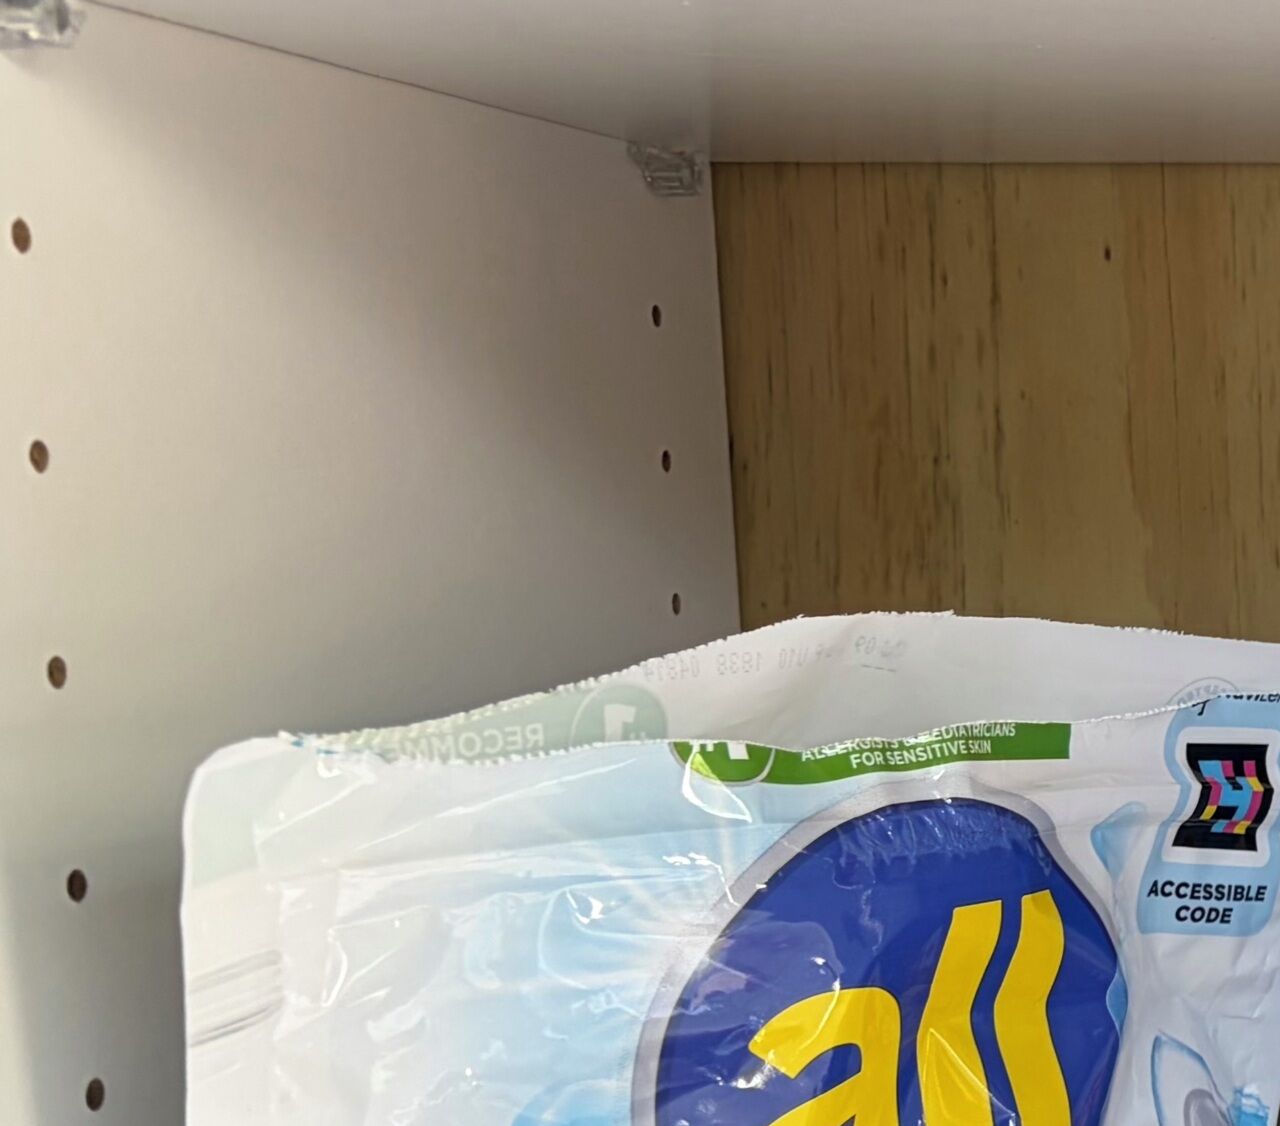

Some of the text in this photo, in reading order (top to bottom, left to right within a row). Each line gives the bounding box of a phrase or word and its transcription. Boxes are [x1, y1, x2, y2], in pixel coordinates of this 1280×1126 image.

[850, 740, 992, 769] FOR SENSITIVE SKIN
[1147, 879, 1268, 902] ACCESSIBLE
[1175, 905, 1234, 924] CODE
